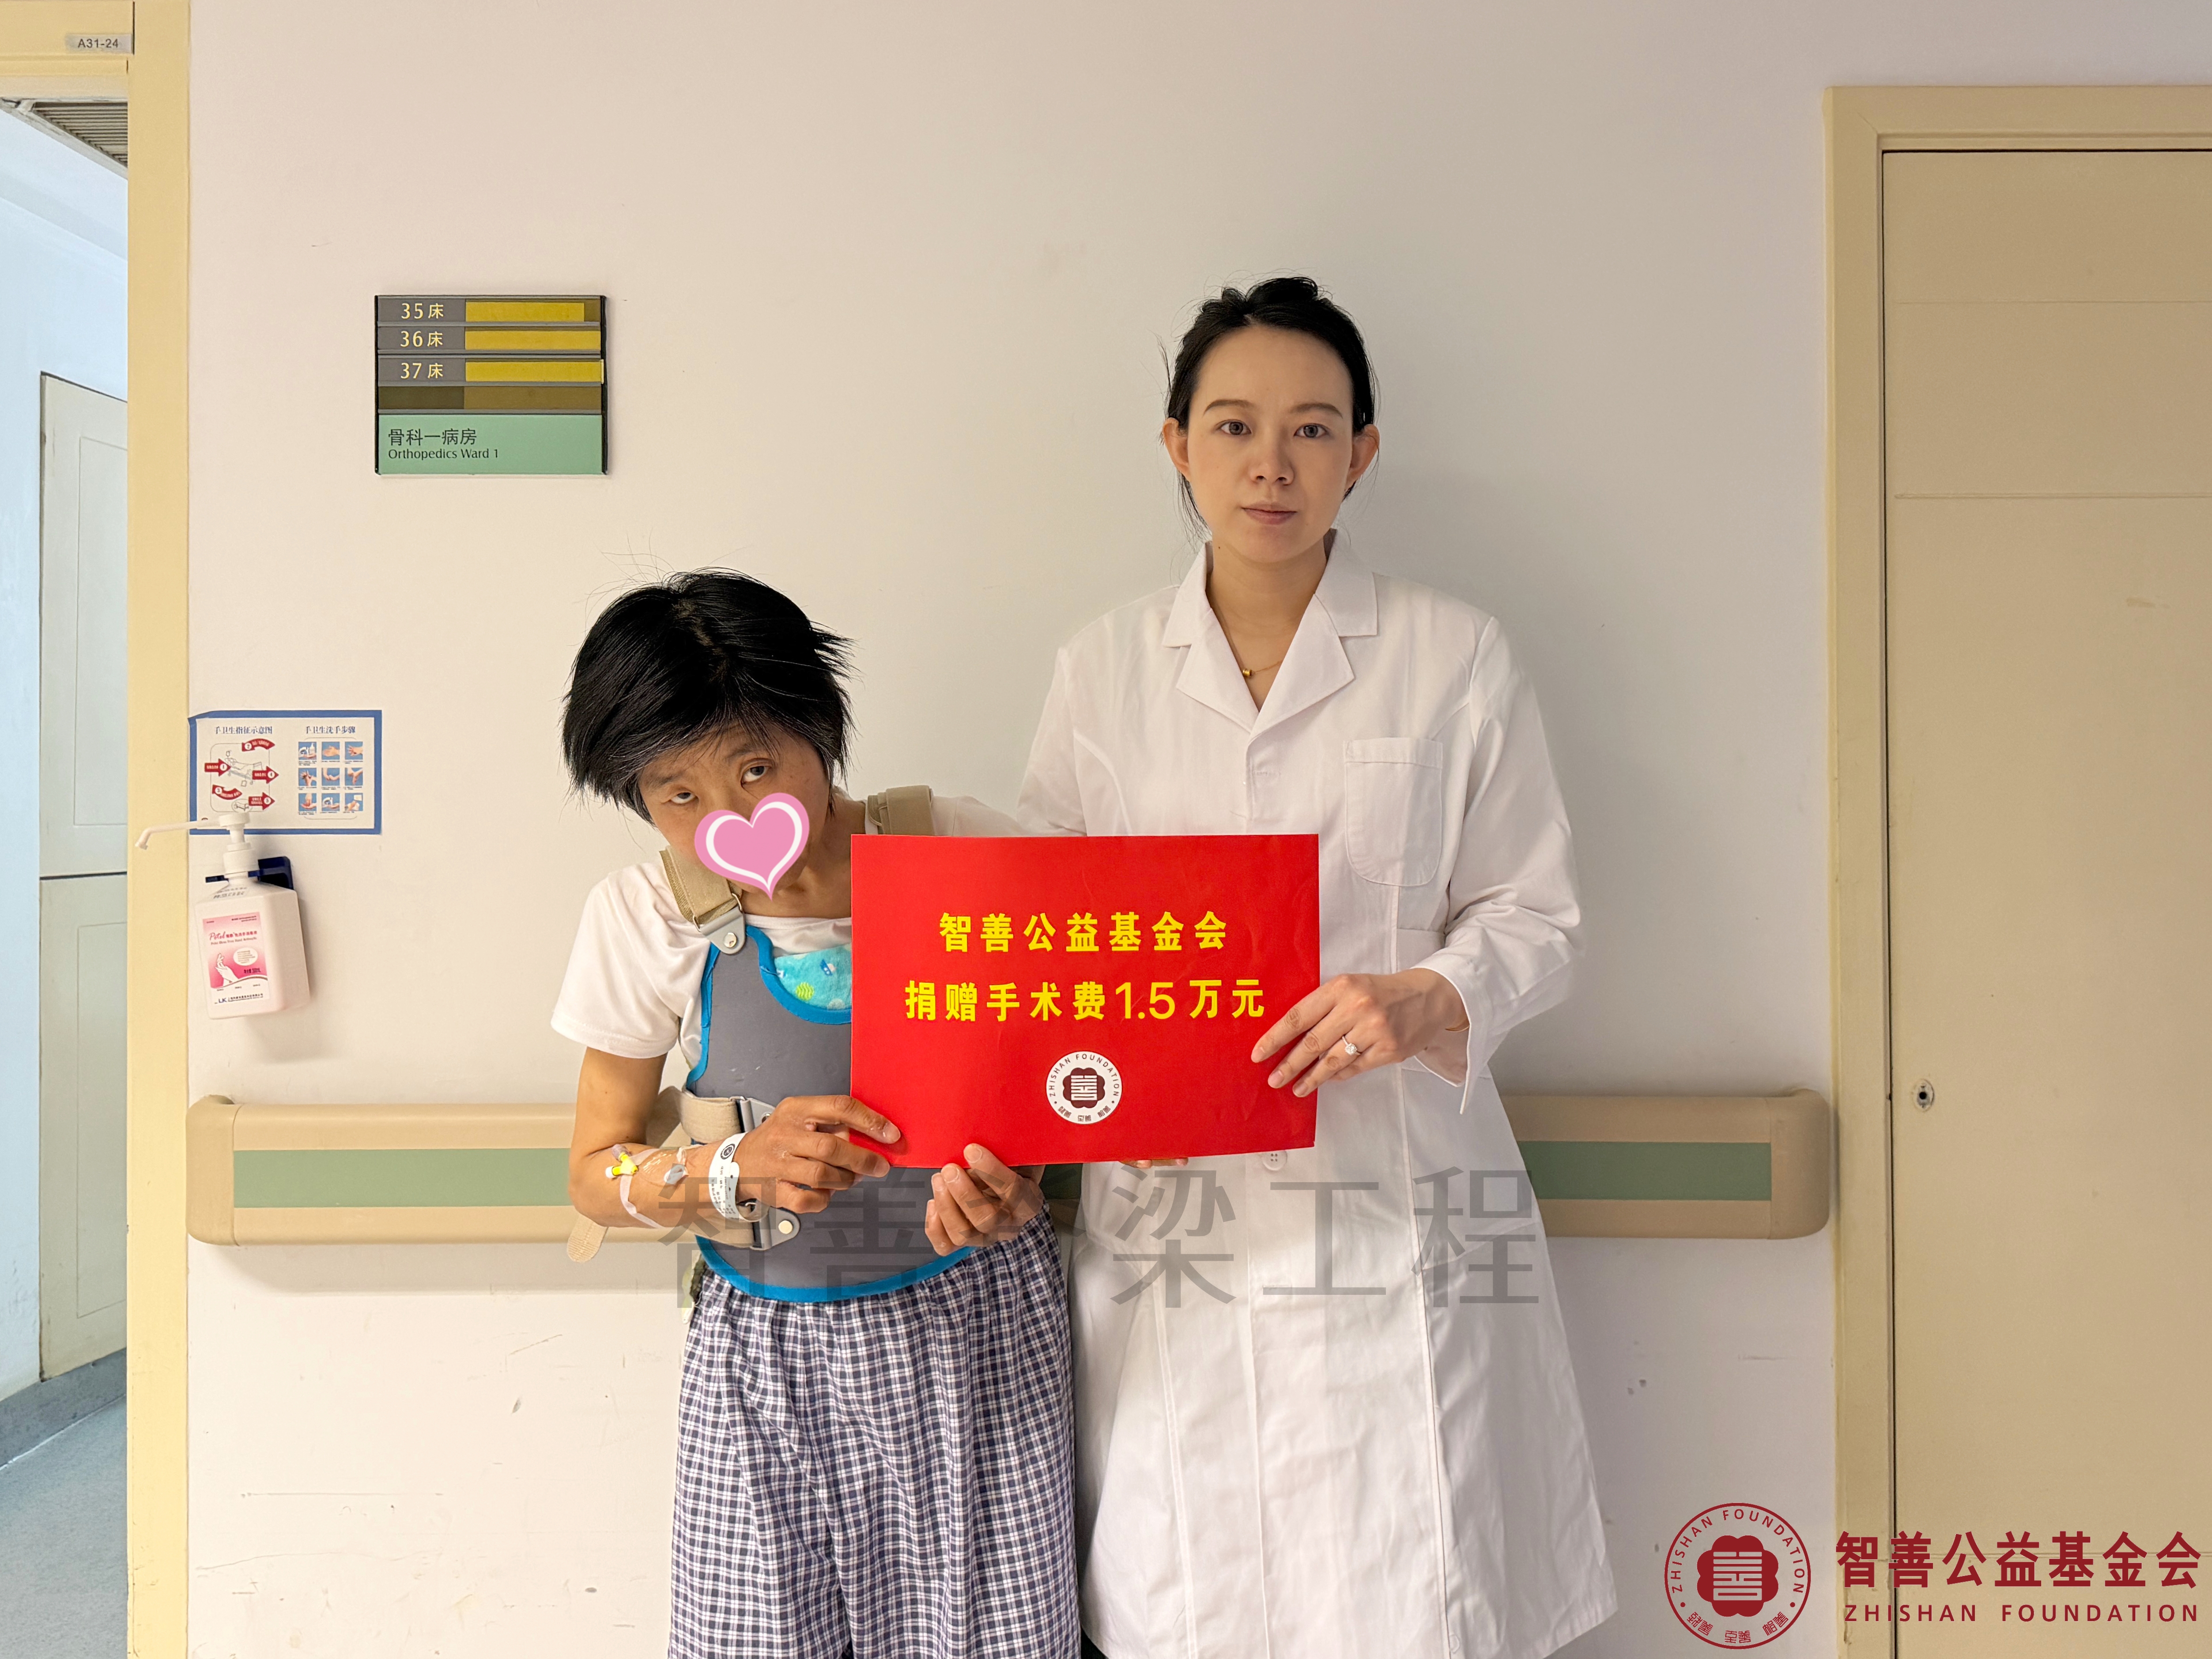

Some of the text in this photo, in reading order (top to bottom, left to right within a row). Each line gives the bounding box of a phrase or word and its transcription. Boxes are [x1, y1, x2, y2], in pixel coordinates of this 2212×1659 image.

[78, 38, 118, 48] A31-24
[401, 303, 444, 319] 35床
[400, 331, 443, 347] 36床
[400, 362, 443, 379] 37床
[388, 428, 477, 446] 骨科一病房
[389, 449, 498, 460] Orthopedics Ward 1
[940, 911, 1227, 953] 智善公益基金会
[904, 979, 1265, 1022] 捐赠手术费1.5万元
[1049, 1053, 1120, 1097] ZHISHAN FOUNDATION
